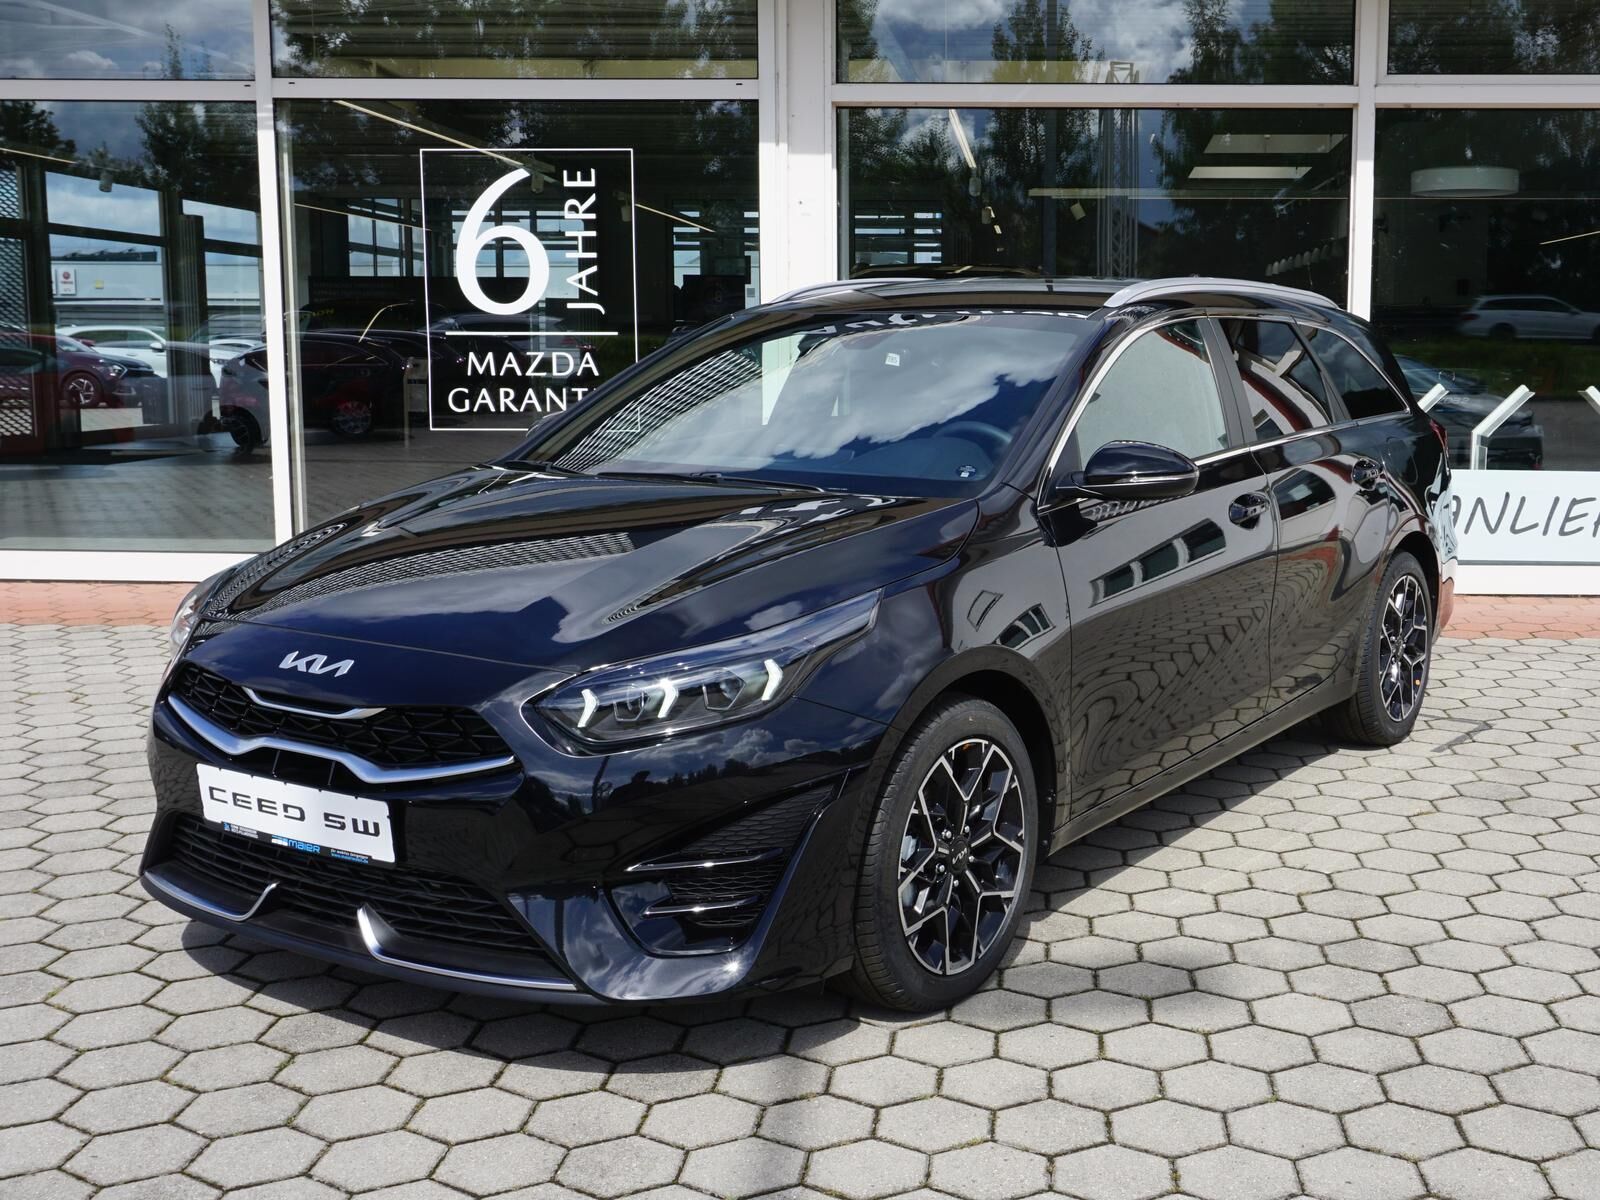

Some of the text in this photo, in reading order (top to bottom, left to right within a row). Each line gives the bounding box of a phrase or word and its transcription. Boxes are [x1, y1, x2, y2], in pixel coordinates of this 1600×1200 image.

[456, 168, 549, 315] 6
[563, 168, 605, 315] JAHRE
[467, 351, 599, 376] MAZDA
[448, 387, 597, 413] GARANT
[279, 651, 354, 677] KIA
[208, 785, 381, 838] CEED SW
